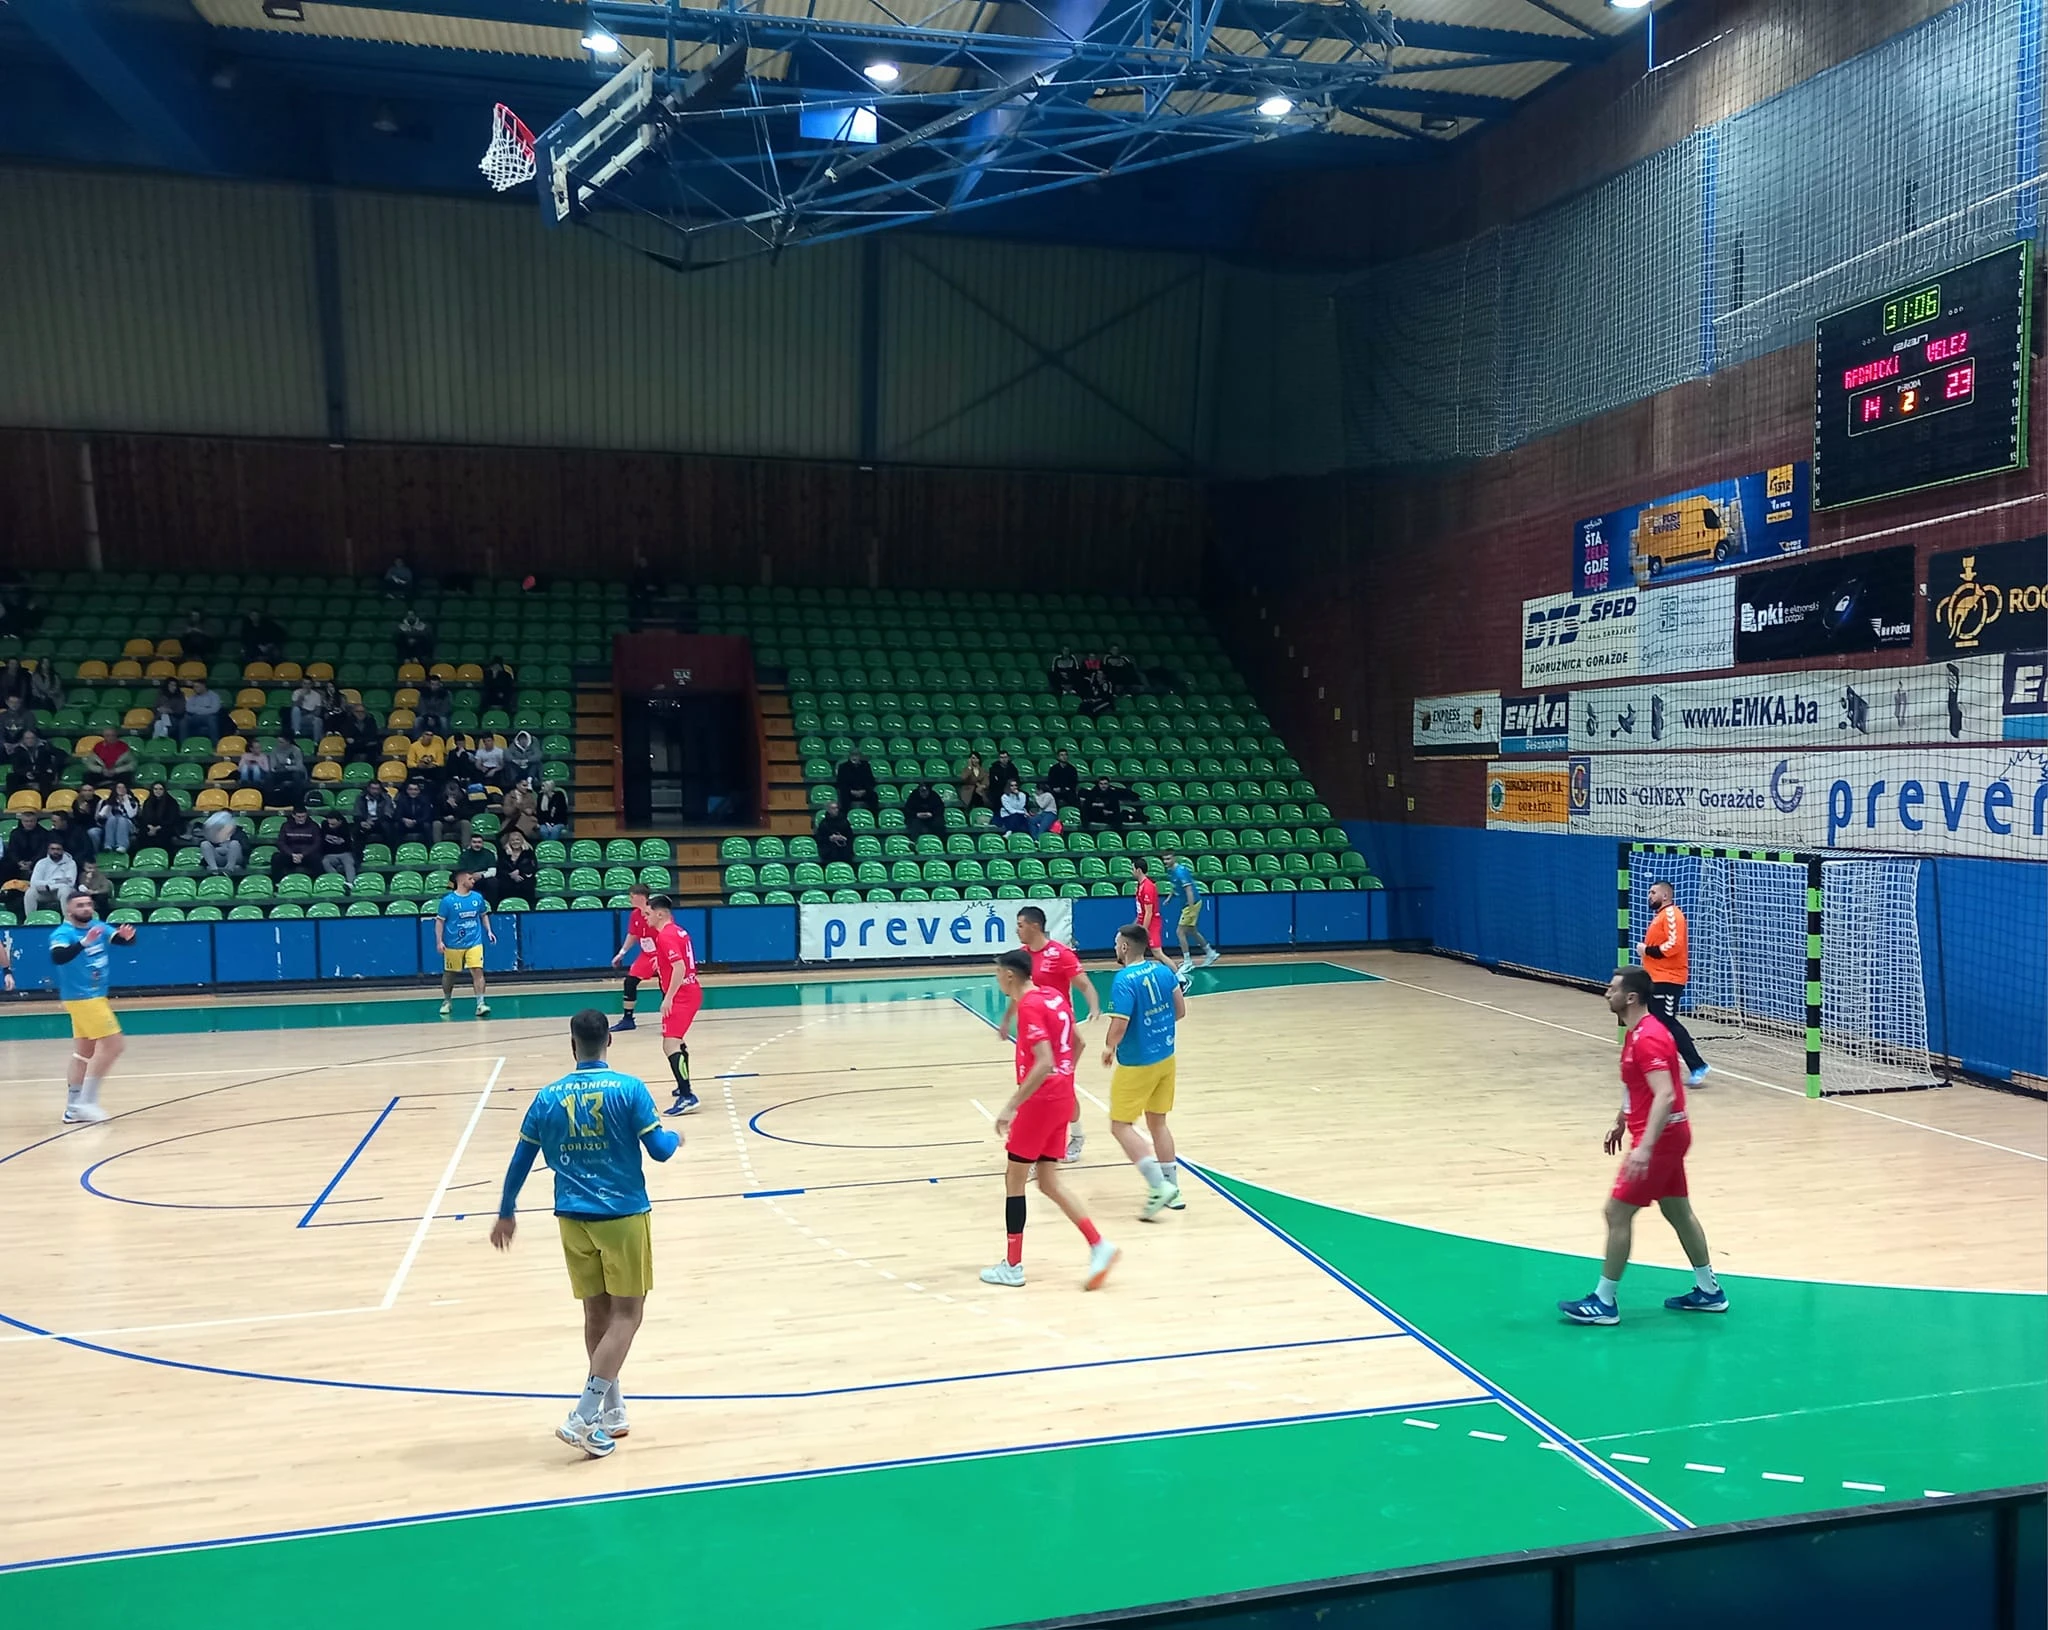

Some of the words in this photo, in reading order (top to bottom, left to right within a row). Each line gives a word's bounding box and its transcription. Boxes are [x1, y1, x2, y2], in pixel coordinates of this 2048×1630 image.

[1885, 289, 1938, 330] 31:06
[1893, 334, 1929, 352] elan
[1926, 333, 1968, 362] VELEZ
[1946, 368, 1971, 398] 23
[1864, 396, 1881, 422] 14
[1902, 391, 1915, 412] 2
[1584, 530, 1602, 548] ŠTA
[1583, 557, 1609, 576] GDJE
[1529, 657, 1582, 674] PODRUŽNICA
[1585, 651, 1629, 668] GORAŽDE
[2010, 665, 2048, 704] E
[1503, 694, 1567, 737] EMKA
[1682, 694, 1819, 729] www.EMKA.ba
[1595, 787, 1628, 806] UNIS
[1699, 788, 1766, 809] Goražde
[824, 915, 1005, 959] preven
[560, 1091, 605, 1137] 13
